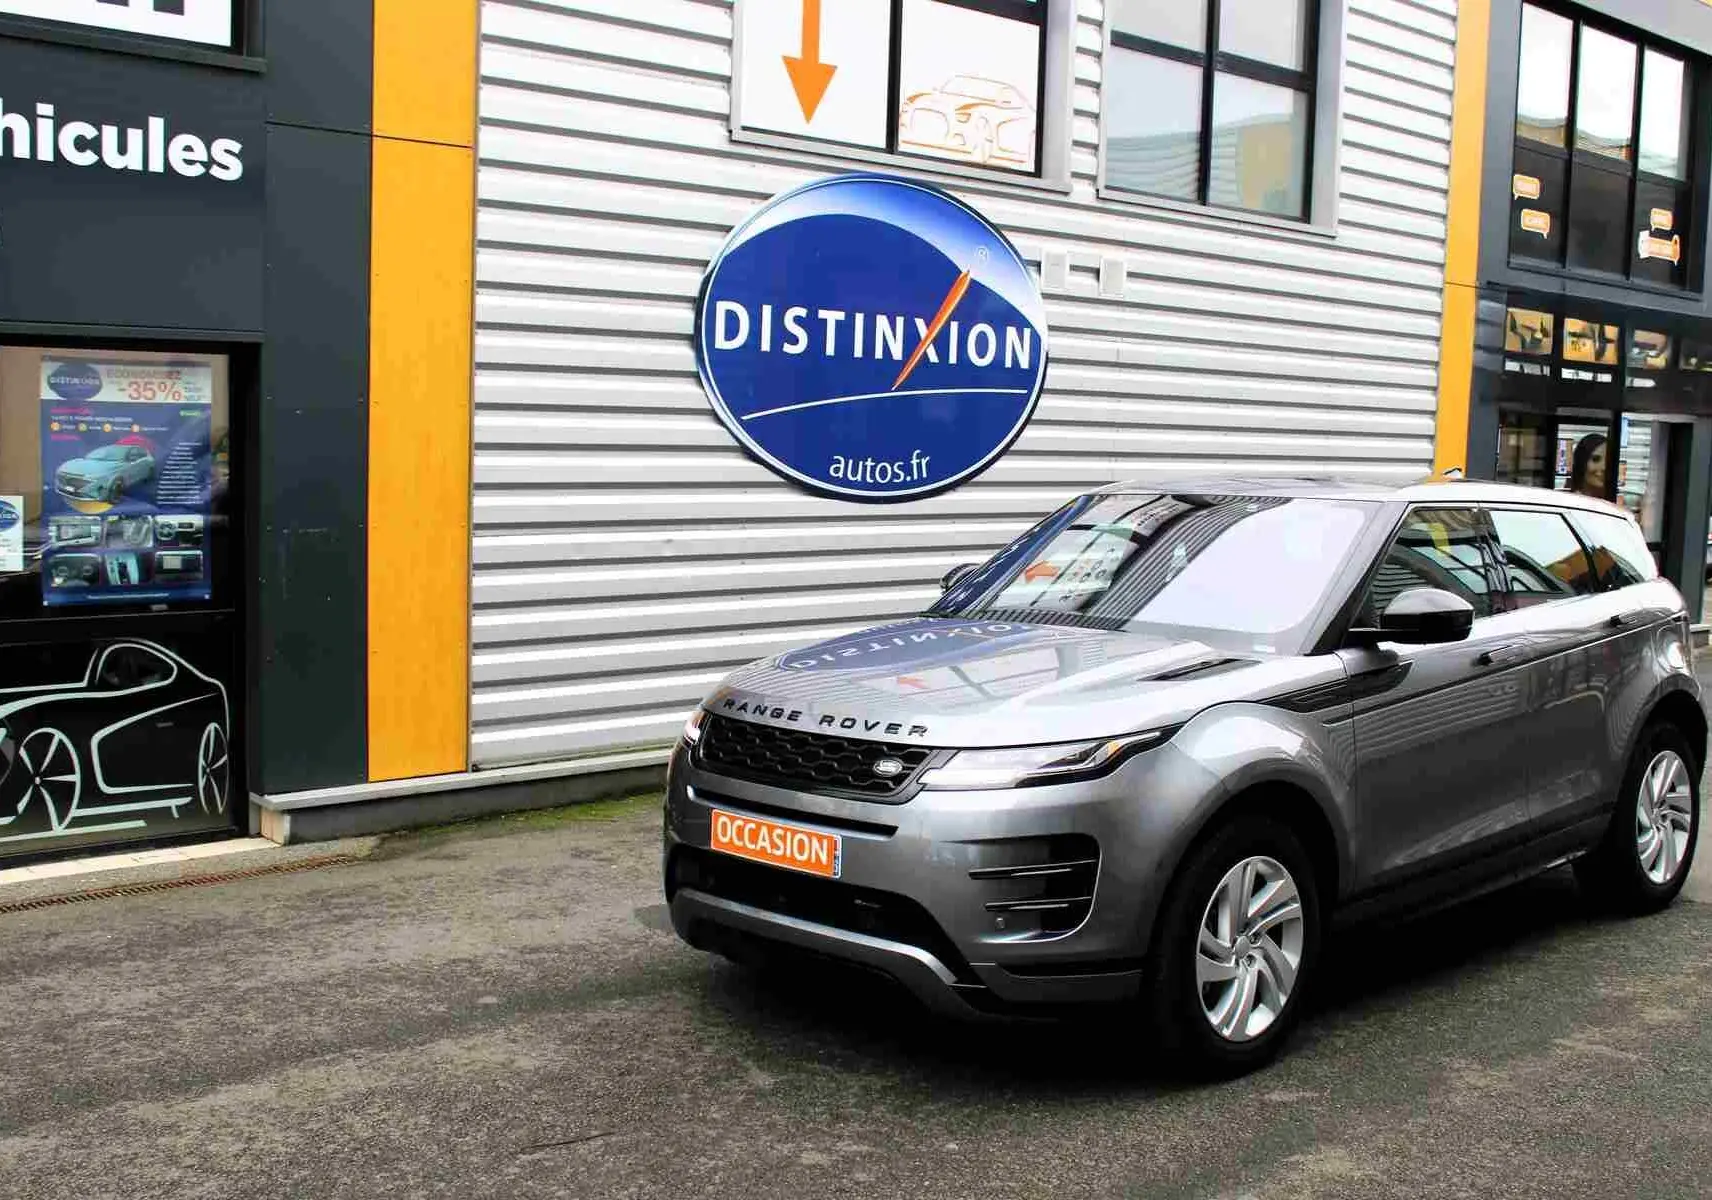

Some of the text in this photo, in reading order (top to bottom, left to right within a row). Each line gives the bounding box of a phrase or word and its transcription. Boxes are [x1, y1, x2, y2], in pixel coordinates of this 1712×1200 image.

[714, 300, 1031, 369] DISTINXION
[829, 450, 931, 484] autos.fr
[723, 698, 928, 738] RANGE ROVER
[716, 815, 828, 866] OCCASION
